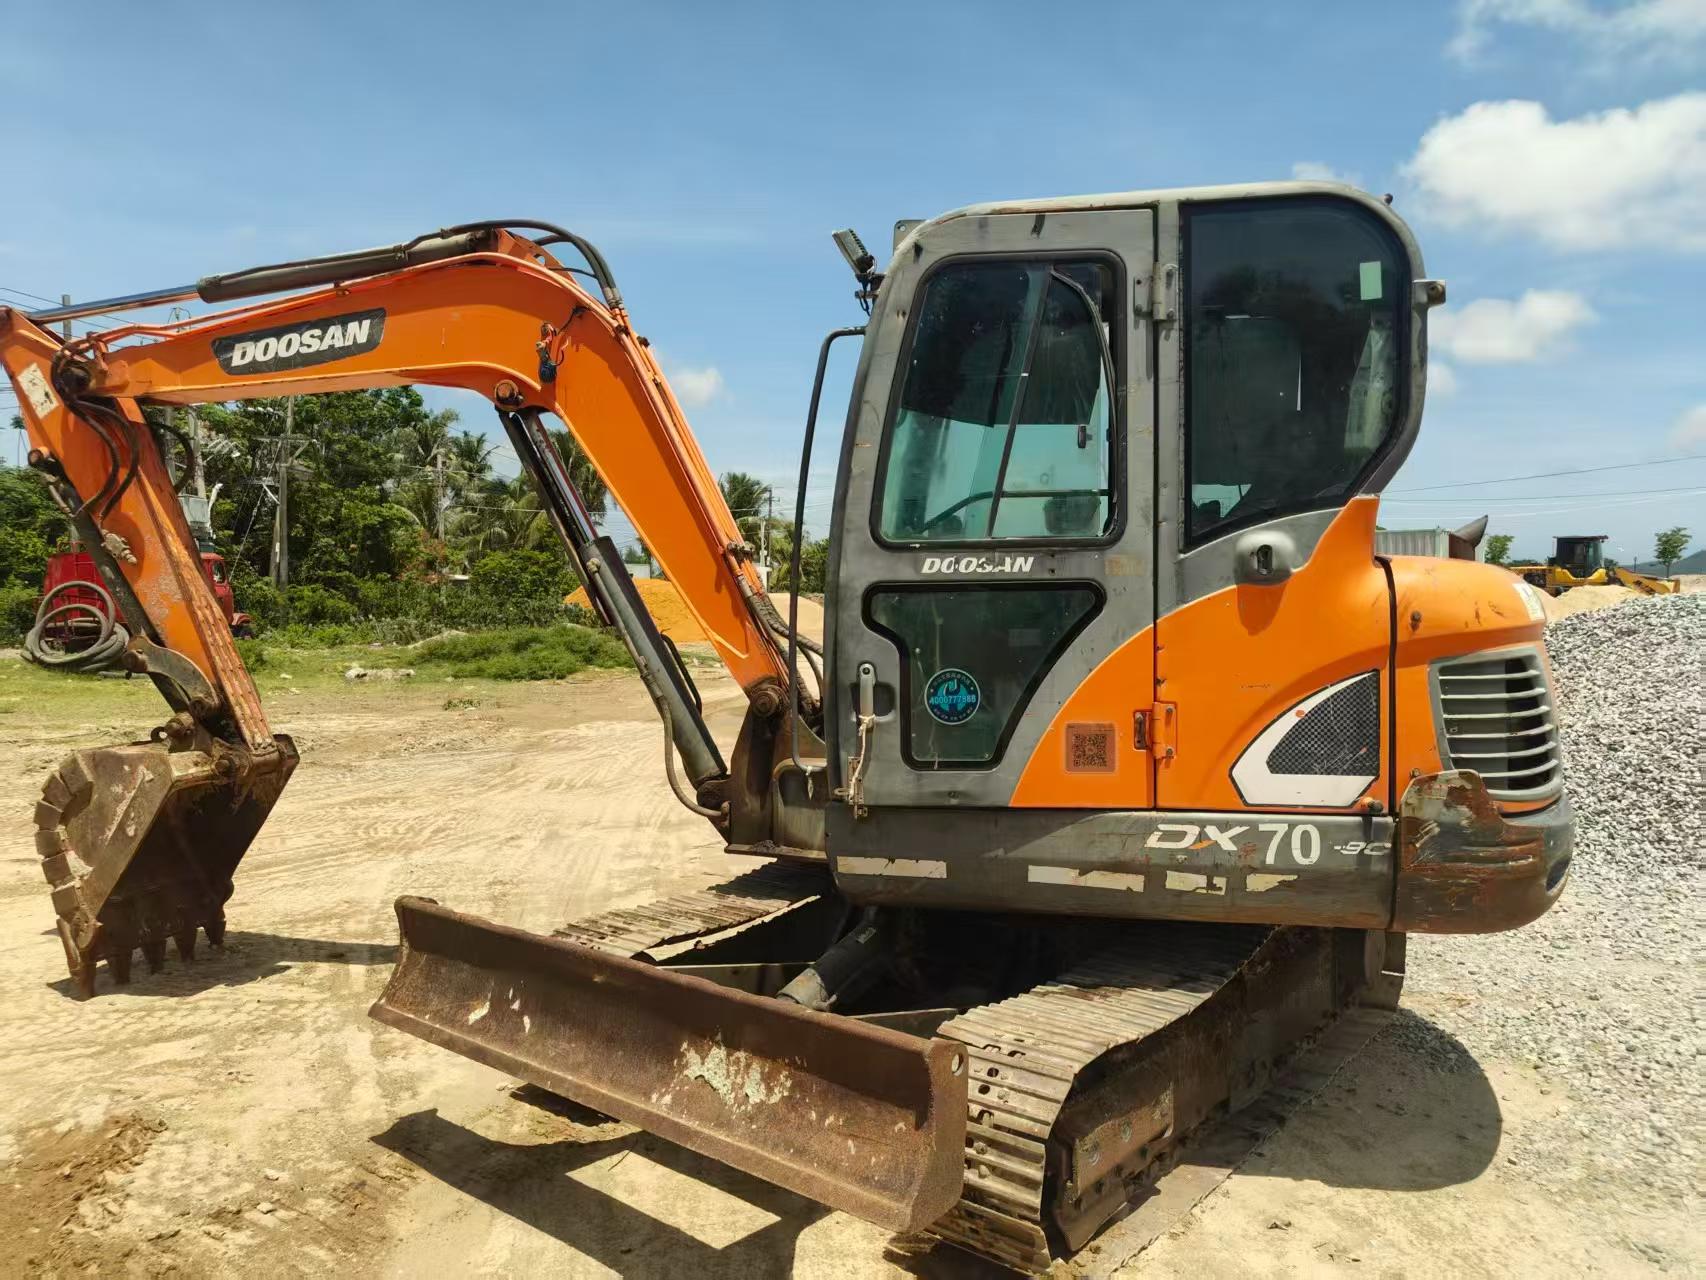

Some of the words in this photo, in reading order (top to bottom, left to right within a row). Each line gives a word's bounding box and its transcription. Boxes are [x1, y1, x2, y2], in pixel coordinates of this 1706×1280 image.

[231, 319, 371, 367] DOOSAN
[921, 556, 1034, 574] DOOSAN
[1143, 824, 1250, 850] DX
[1258, 823, 1321, 865] 70
